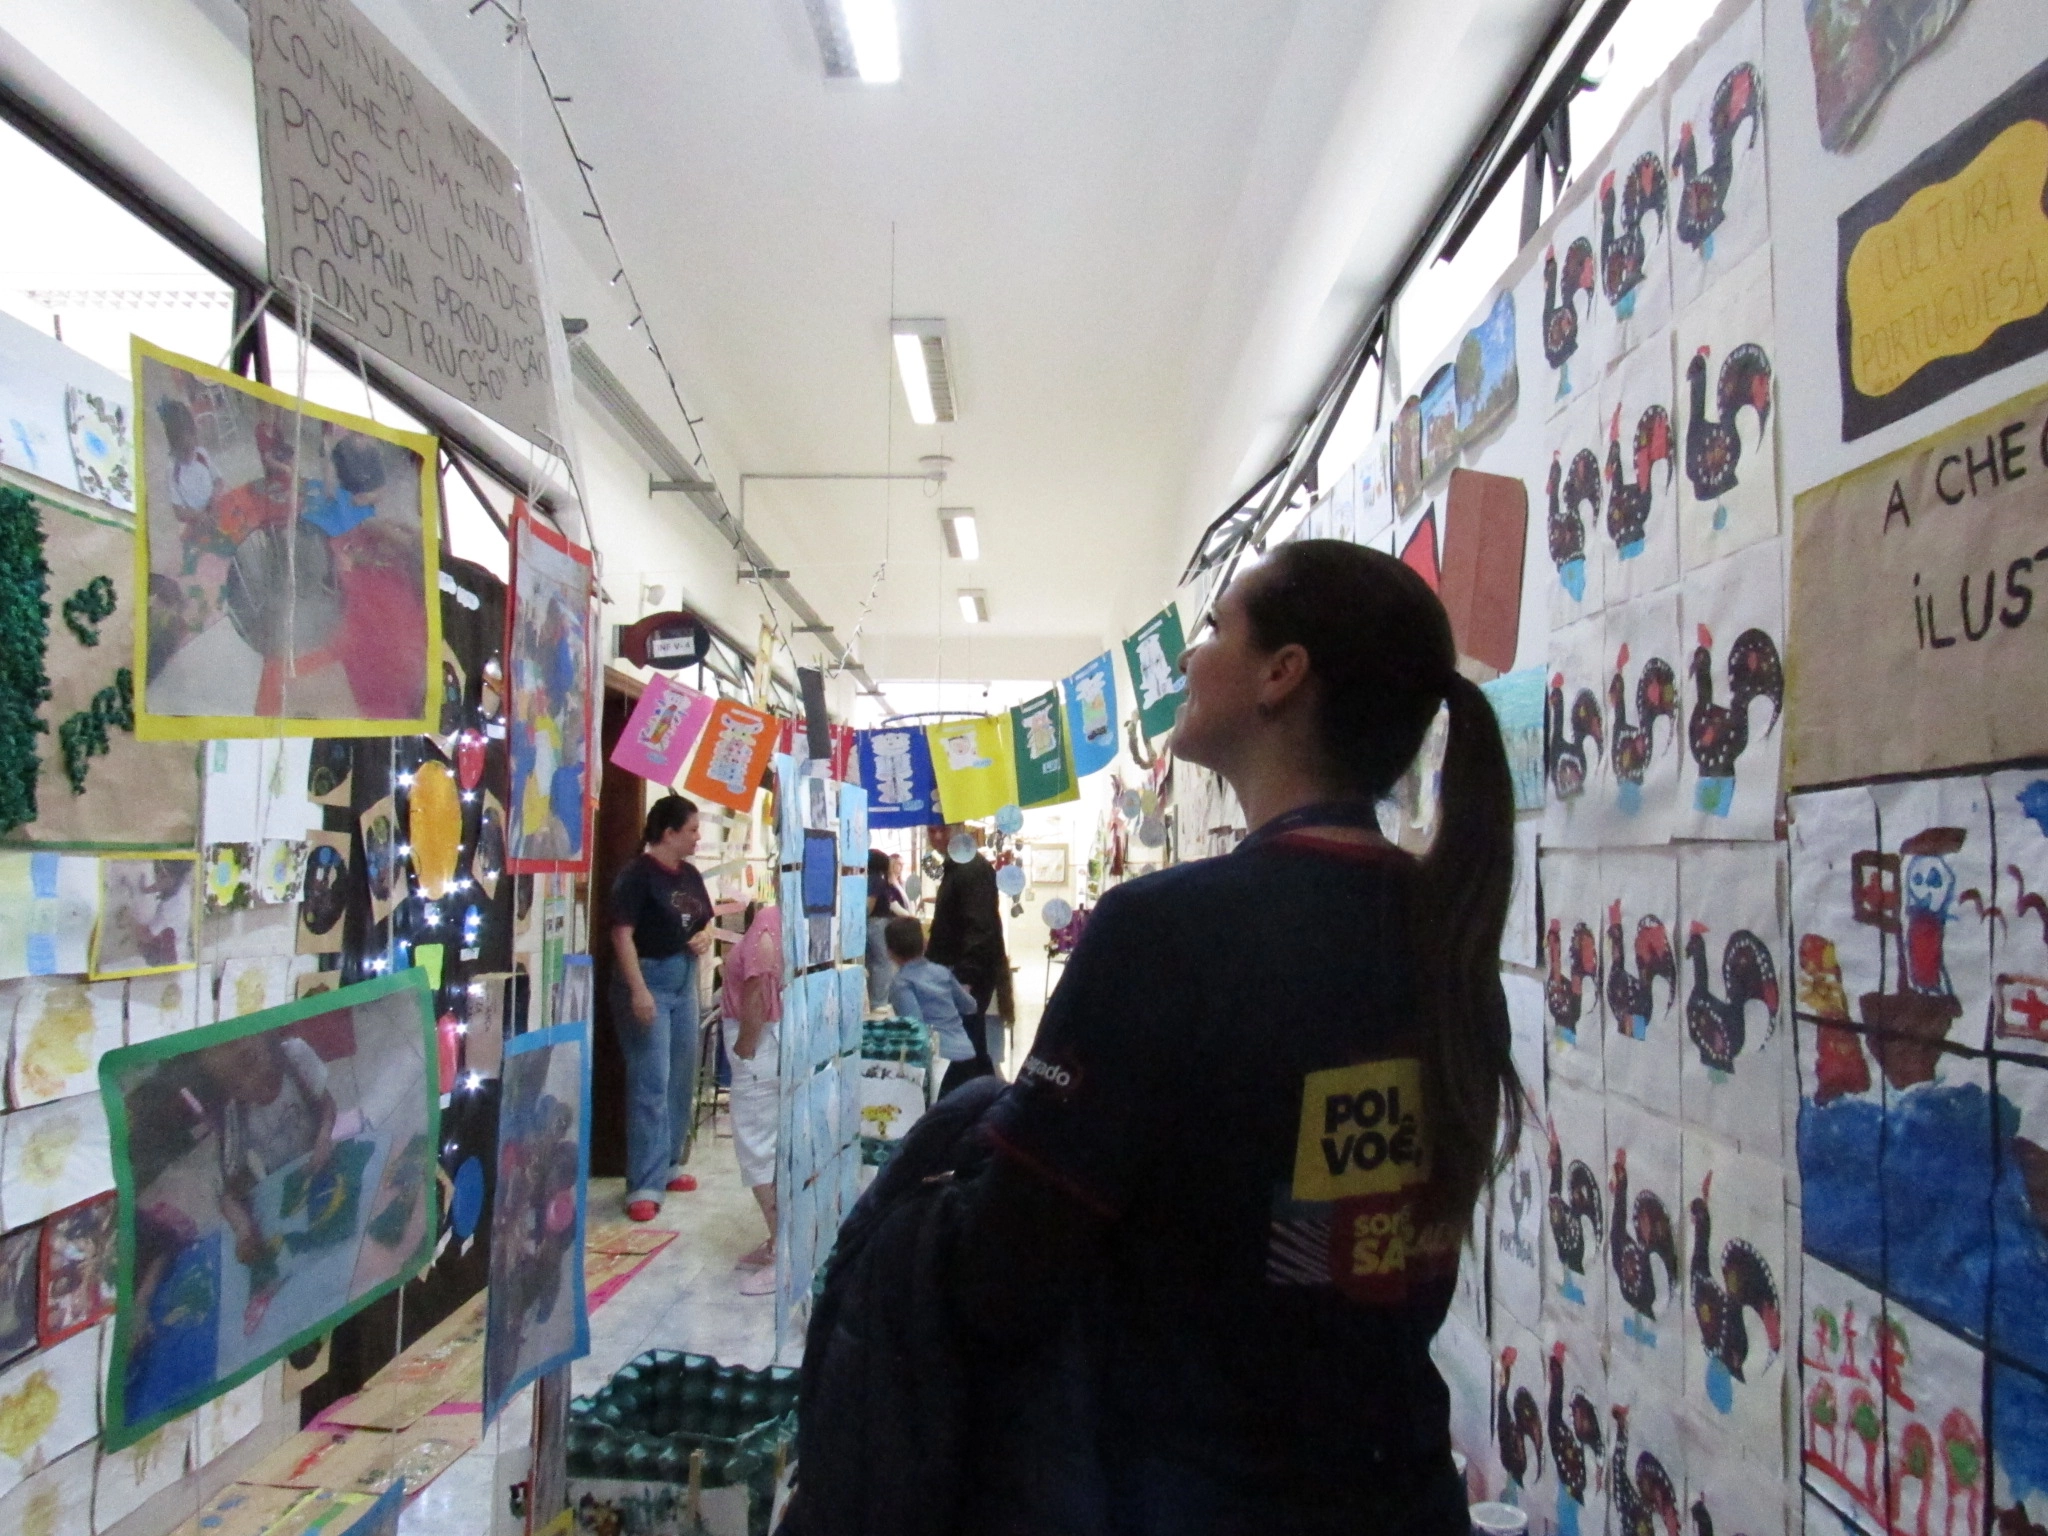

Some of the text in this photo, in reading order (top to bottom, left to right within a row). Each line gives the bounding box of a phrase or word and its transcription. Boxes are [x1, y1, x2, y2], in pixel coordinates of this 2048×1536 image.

[270, 14, 523, 265] CONHECIMENTO
[449, 121, 503, 195] NÃO
[279, 87, 546, 336] POSSIBILIDADES
[1877, 172, 2014, 292] CULTURA
[289, 177, 550, 387] PRÓPRIA PRODUÇÃO
[1859, 247, 2044, 383] PORTUGUESA
[1883, 414, 2048, 535] A CHE
[1914, 546, 2048, 650] iLUS
